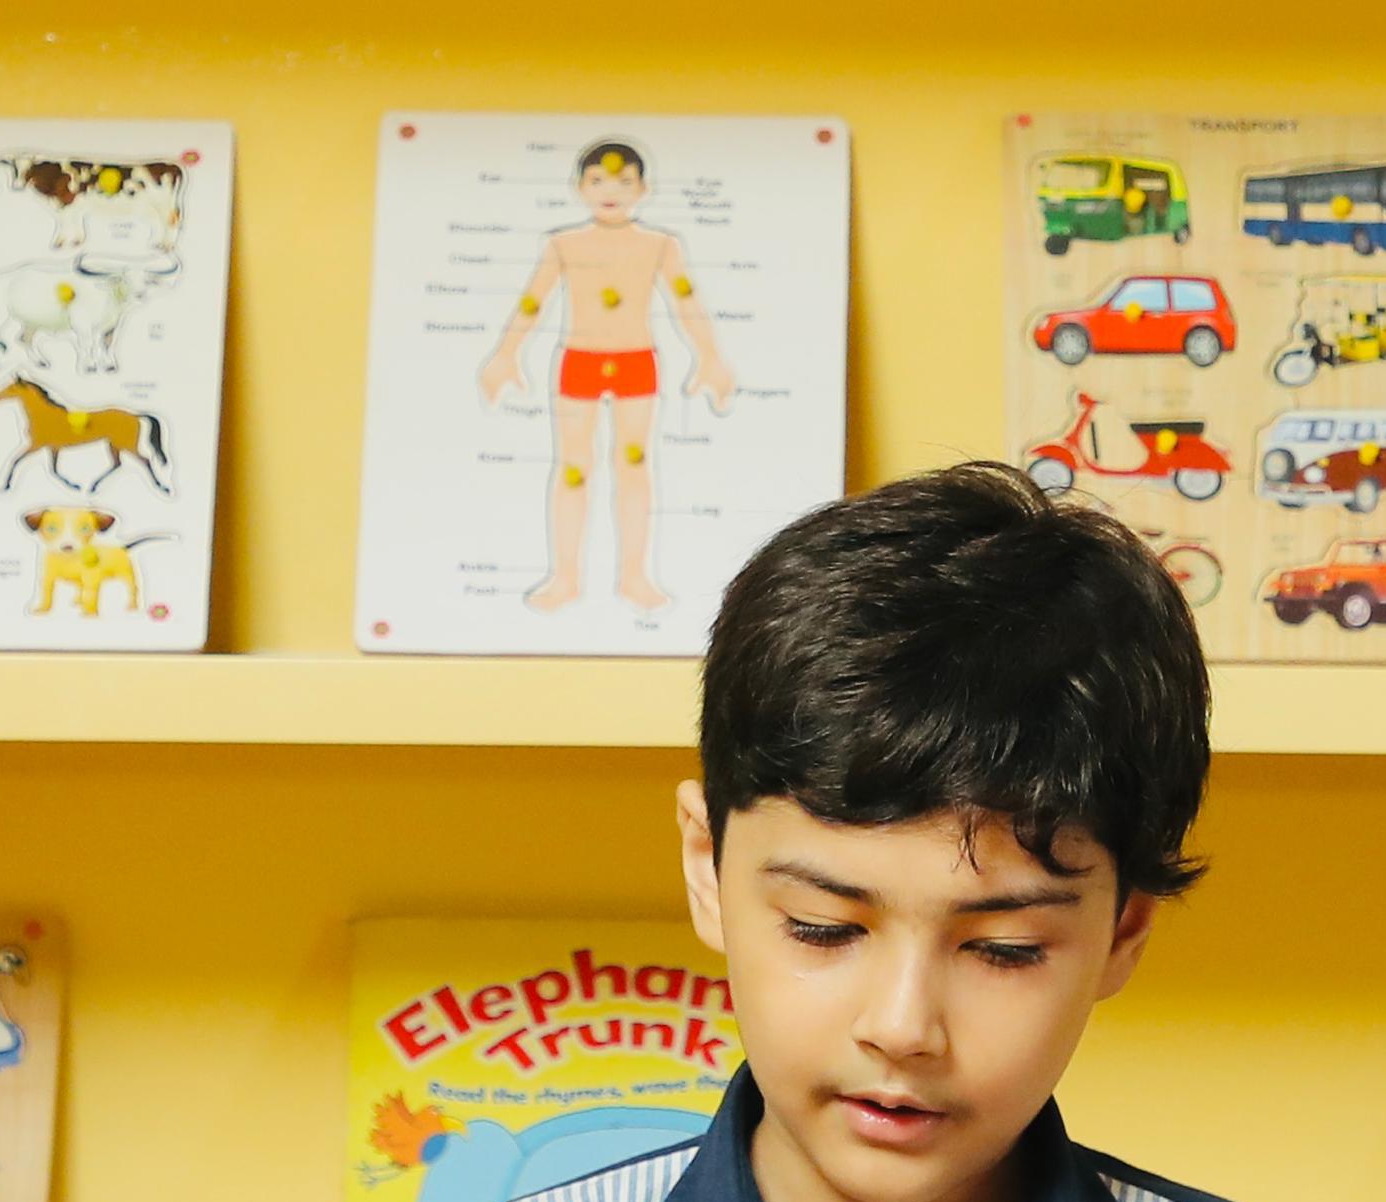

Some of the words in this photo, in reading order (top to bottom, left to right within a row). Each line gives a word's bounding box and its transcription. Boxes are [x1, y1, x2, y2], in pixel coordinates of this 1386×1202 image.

[1191, 118, 1299, 132] TRANSPORT
[384, 949, 735, 1060] Elephan
[484, 1018, 728, 1070] Trunk
